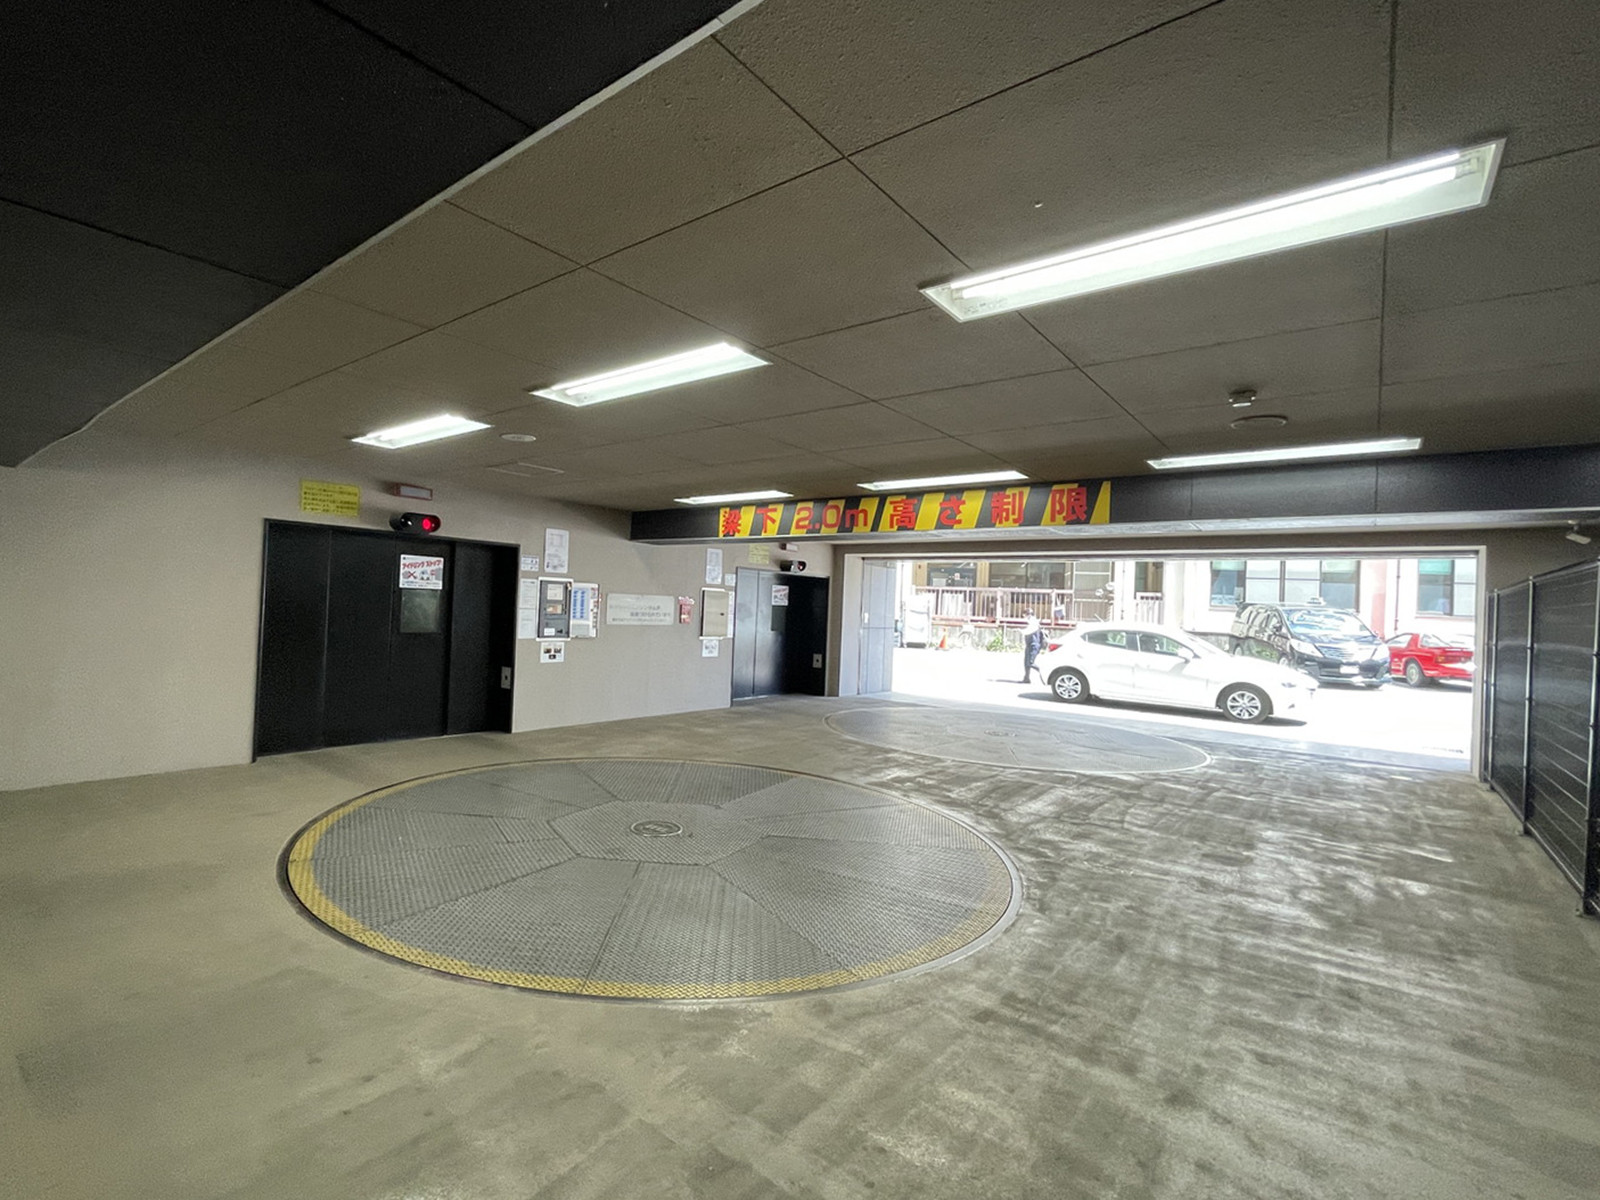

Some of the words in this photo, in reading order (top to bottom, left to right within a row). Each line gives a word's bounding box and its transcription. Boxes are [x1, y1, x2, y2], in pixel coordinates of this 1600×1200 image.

[721, 487, 1088, 535] 梁下2.0m高さ制限
